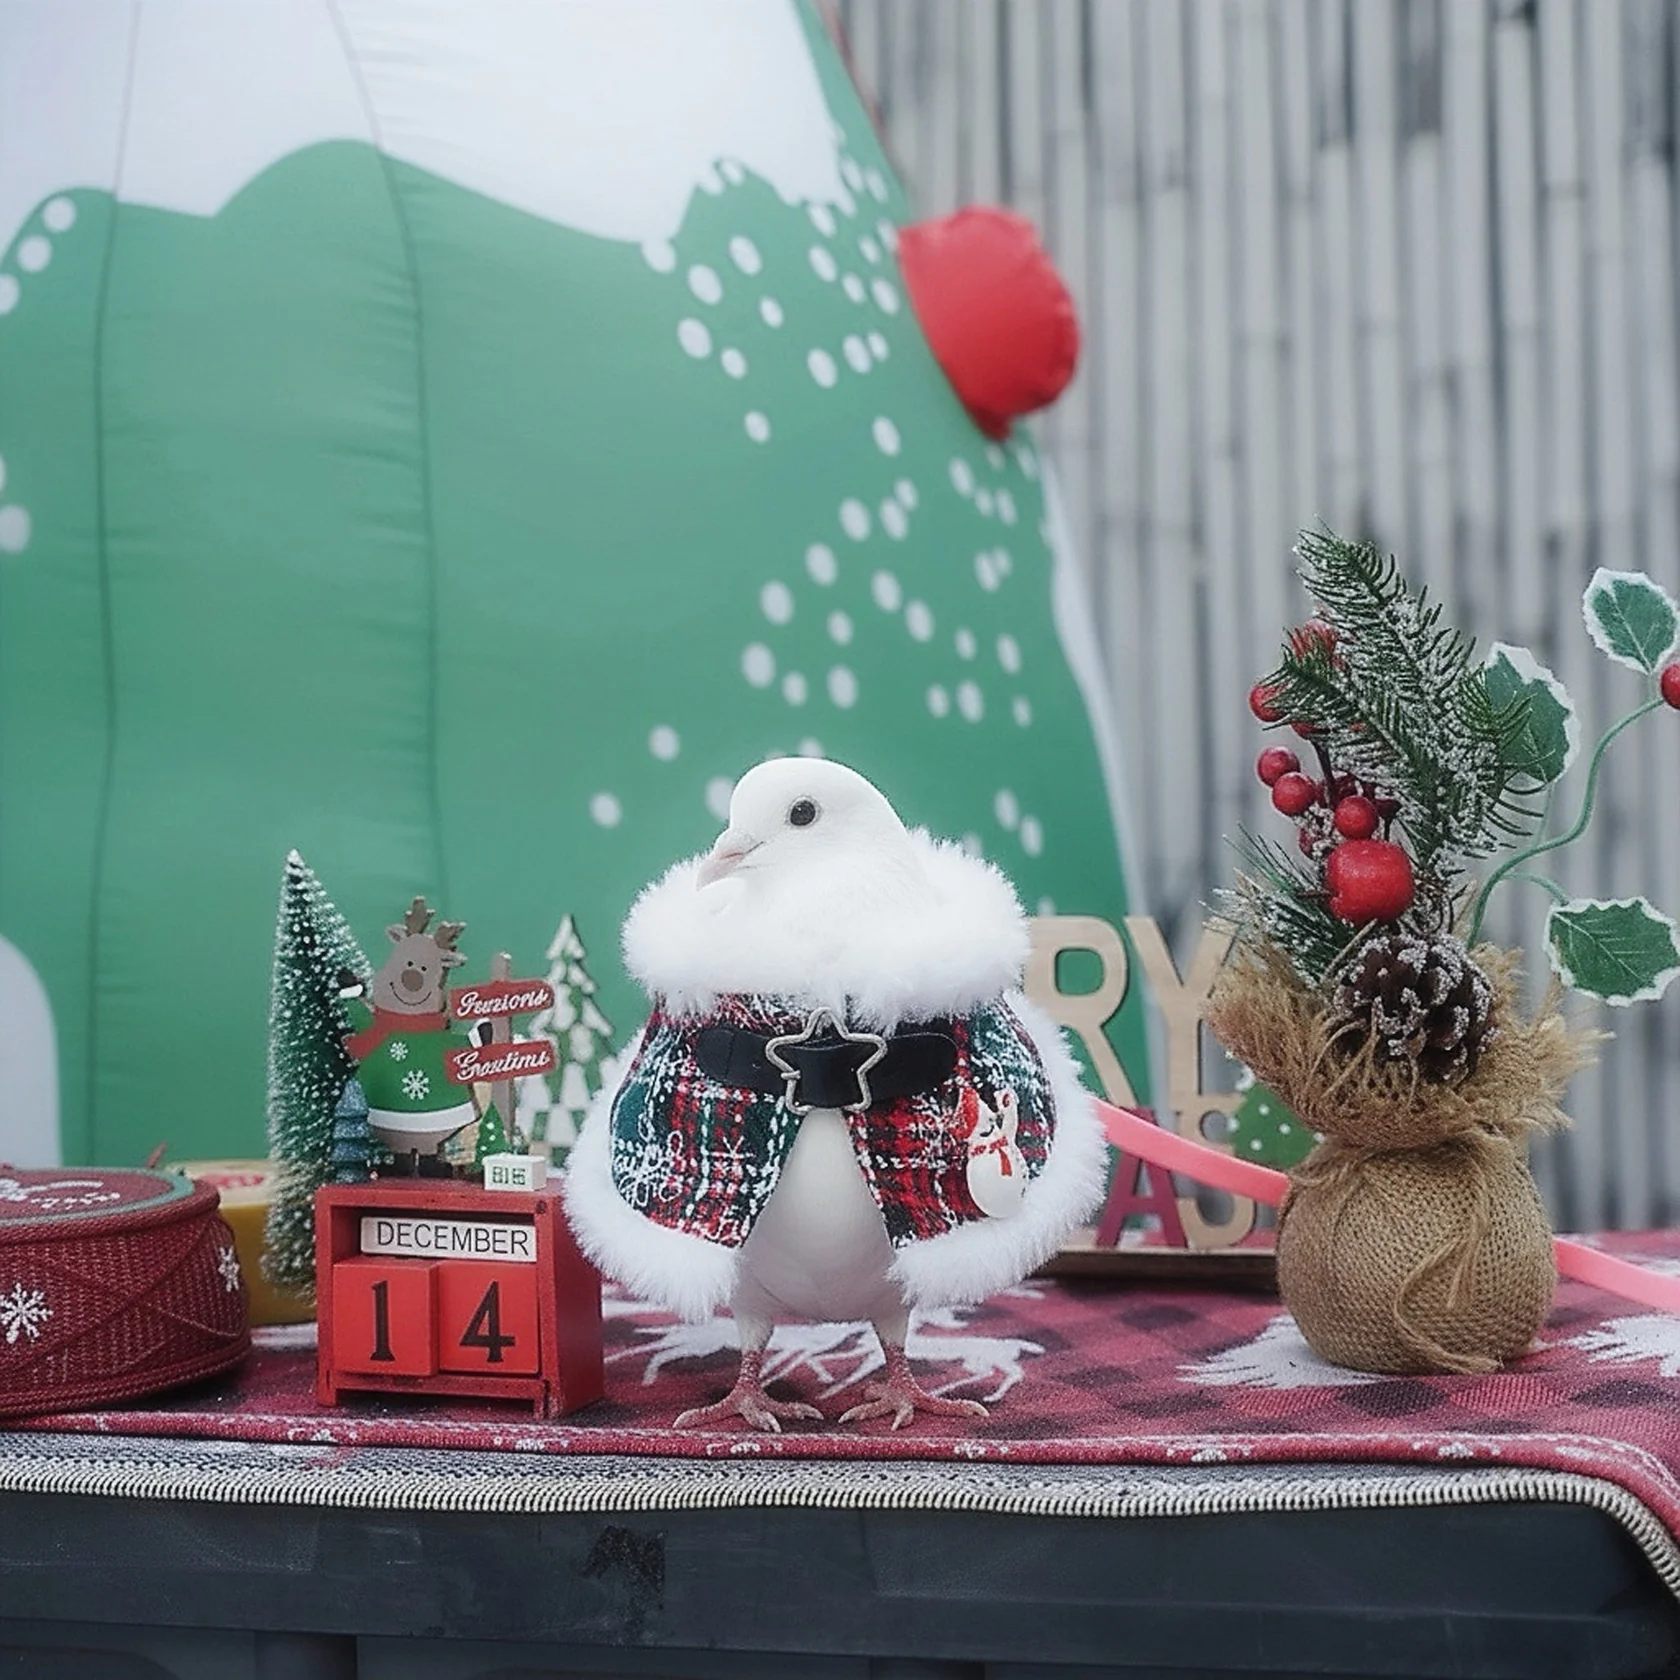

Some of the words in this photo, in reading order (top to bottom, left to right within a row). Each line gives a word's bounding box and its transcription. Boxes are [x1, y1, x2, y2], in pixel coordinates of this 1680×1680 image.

[376, 1221, 529, 1256] DECEMBER
[369, 1280, 396, 1361] 1
[459, 1280, 516, 1362] 4
